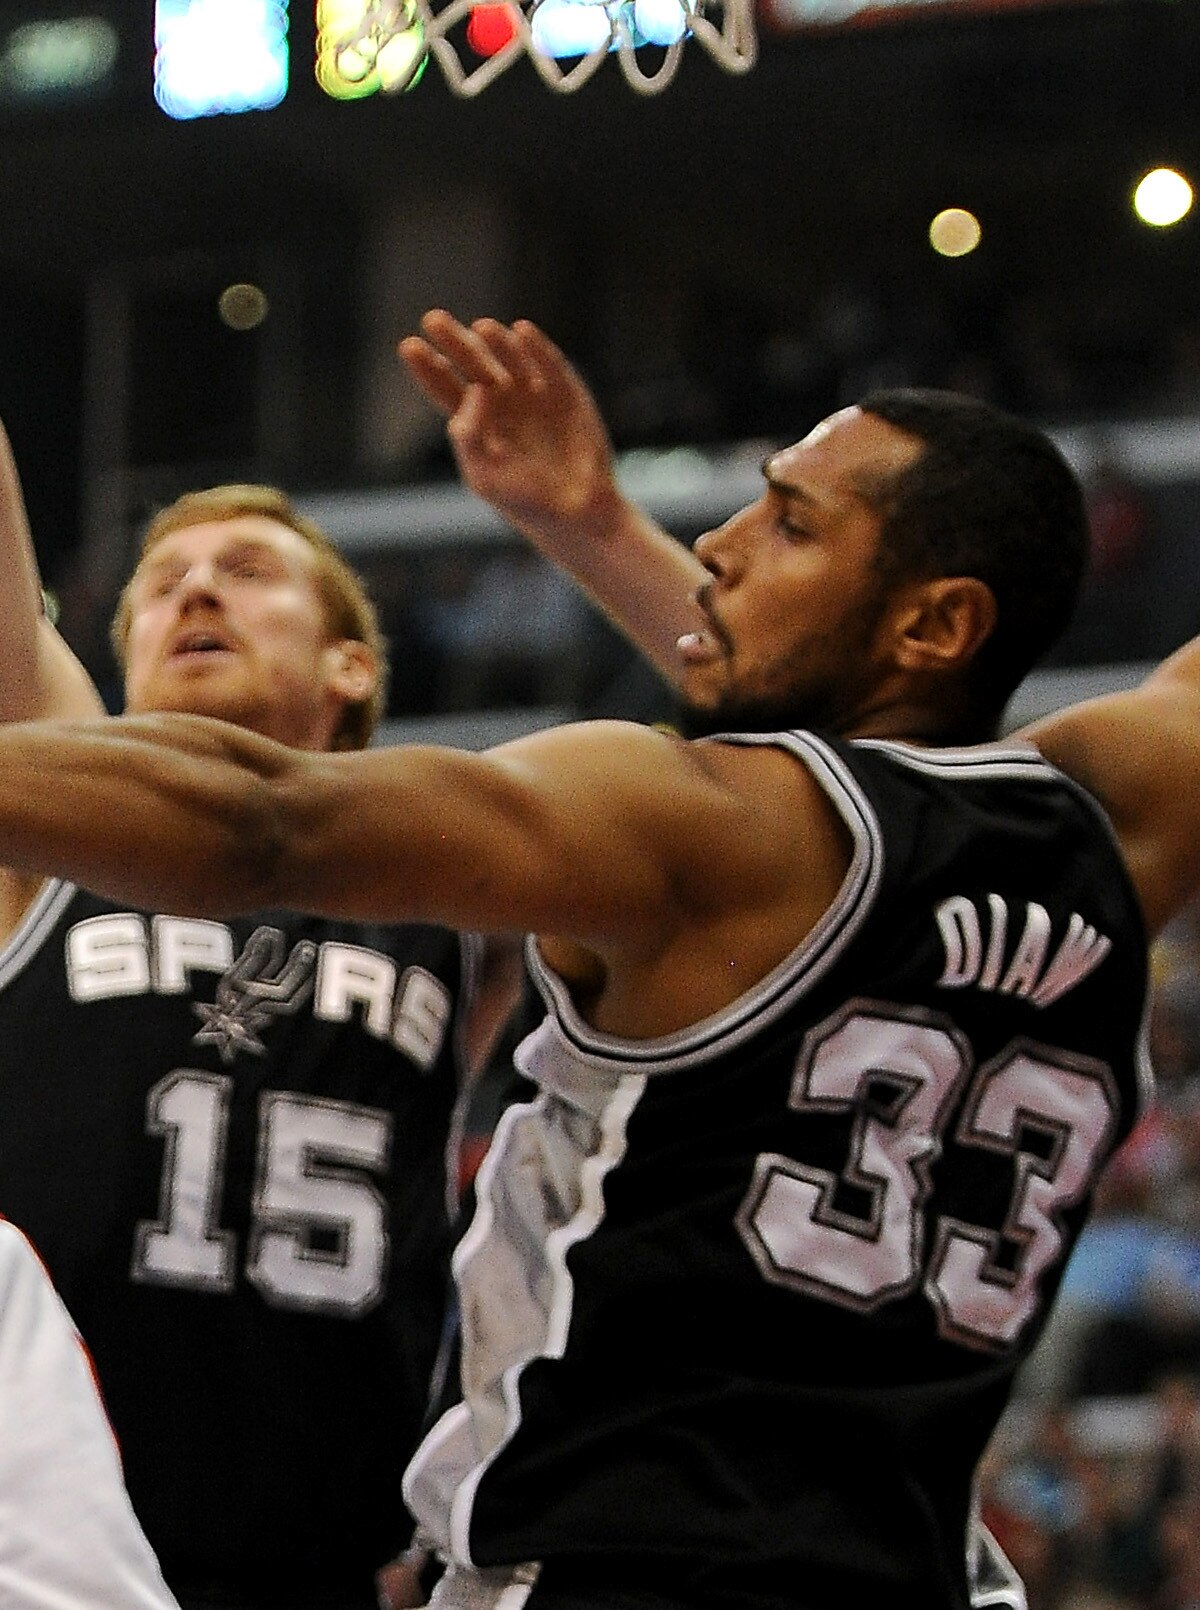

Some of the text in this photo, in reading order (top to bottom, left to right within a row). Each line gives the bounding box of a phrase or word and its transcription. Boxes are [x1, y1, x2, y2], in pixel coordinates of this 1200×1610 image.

[64, 911, 453, 1073] SPURS
[934, 892, 1113, 1009] DIAW
[129, 1066, 395, 1320] 15
[732, 996, 1122, 1355] 33
